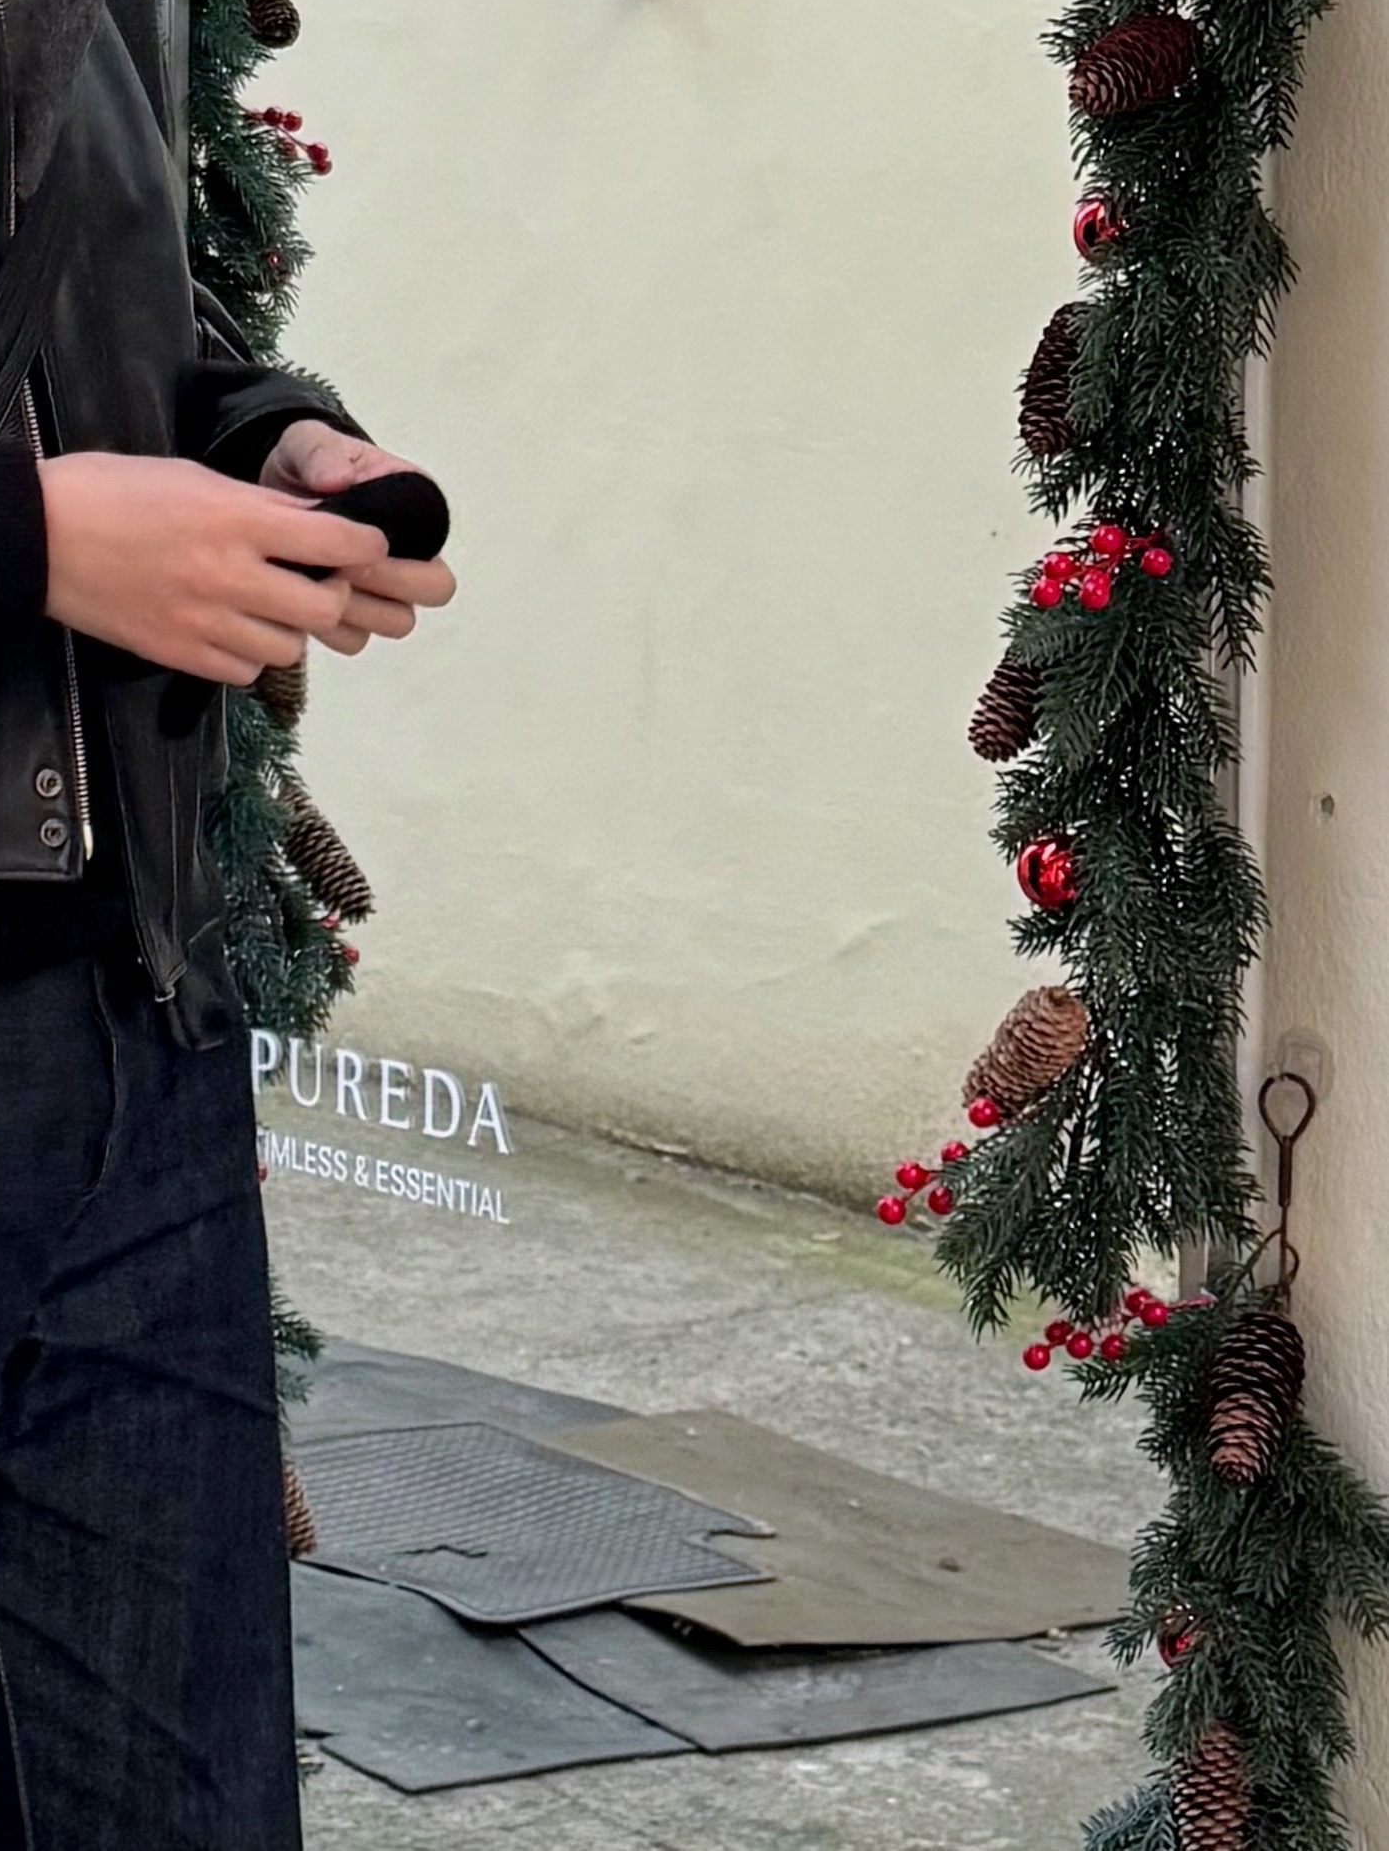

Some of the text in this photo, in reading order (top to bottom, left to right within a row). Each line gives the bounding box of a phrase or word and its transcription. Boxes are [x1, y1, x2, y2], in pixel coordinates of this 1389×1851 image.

[250, 1028, 511, 1154] PUREDA
[354, 1155, 369, 1189] &
[375, 1159, 511, 1225] ESSENTIAL
